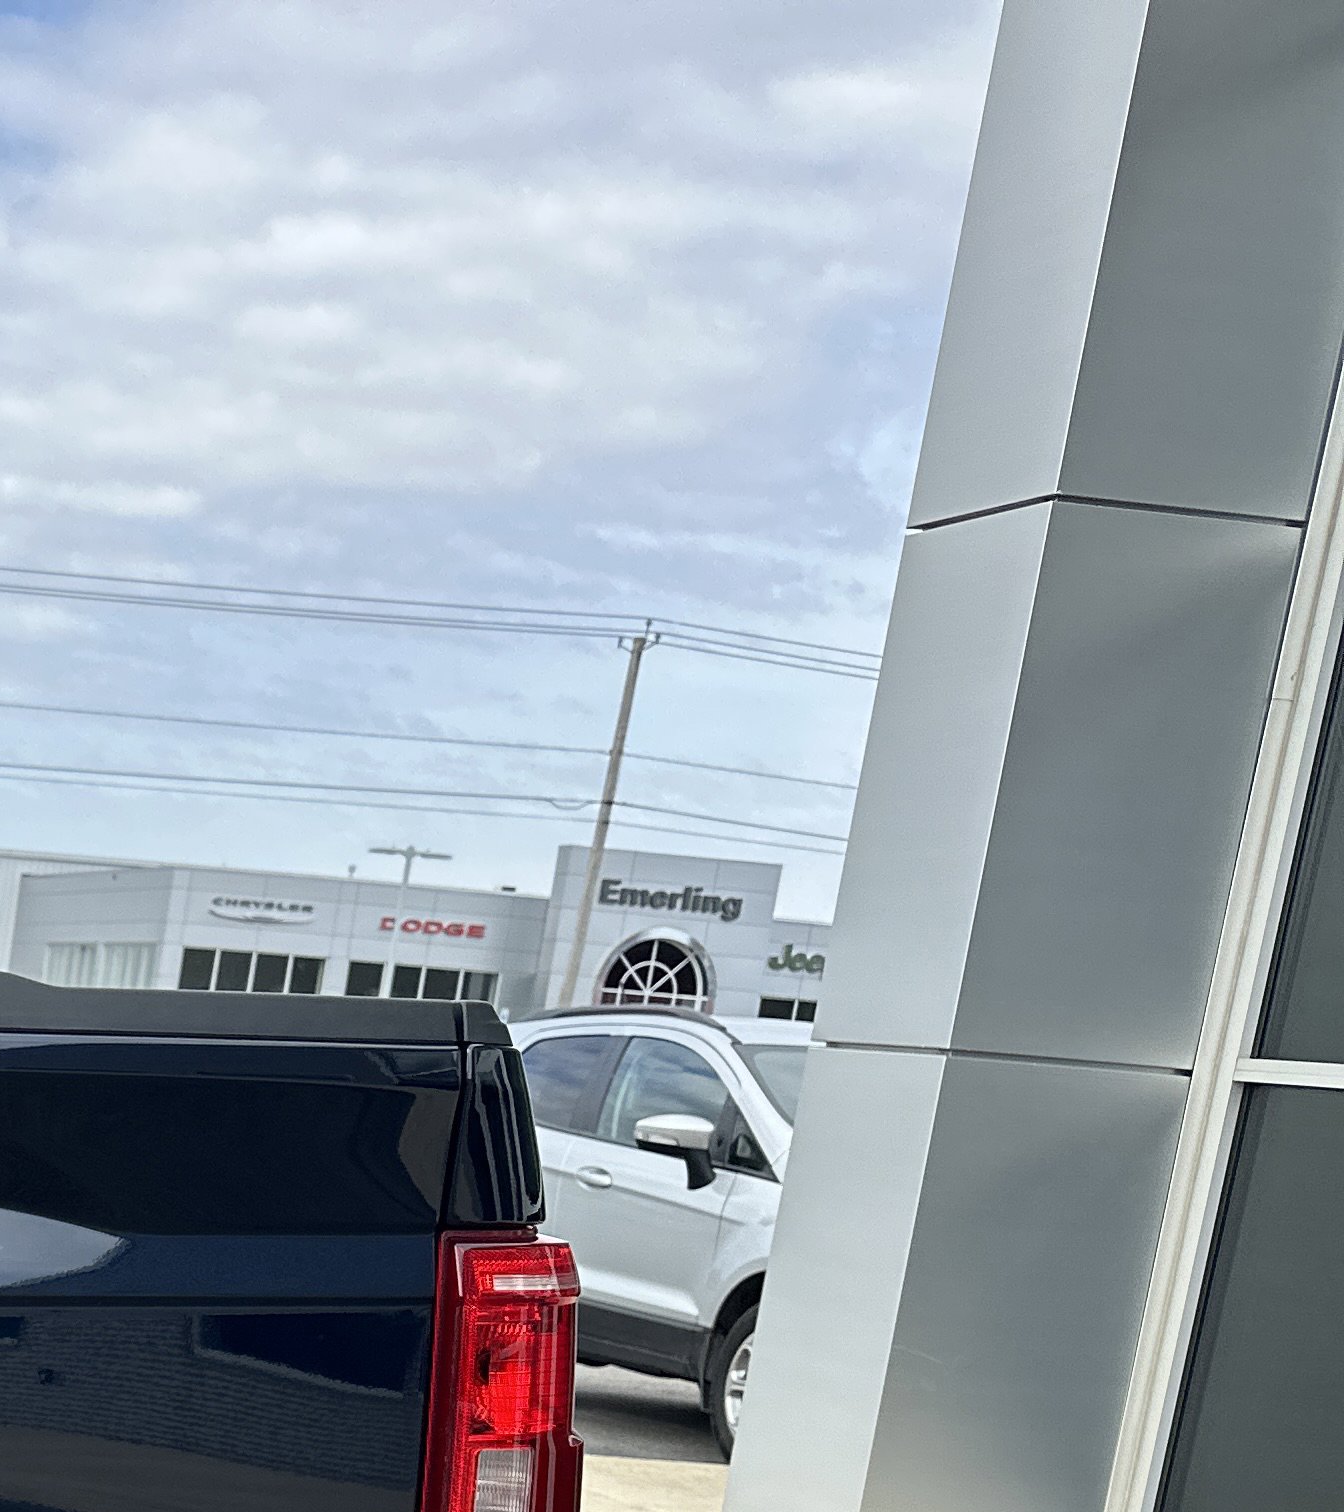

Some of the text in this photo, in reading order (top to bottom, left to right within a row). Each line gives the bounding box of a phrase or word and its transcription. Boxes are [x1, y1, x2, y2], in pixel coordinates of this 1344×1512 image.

[212, 896, 314, 913] CHRYSLER
[598, 878, 743, 922] Emerling
[379, 916, 486, 939] DODGE
[768, 944, 826, 982] Jee
